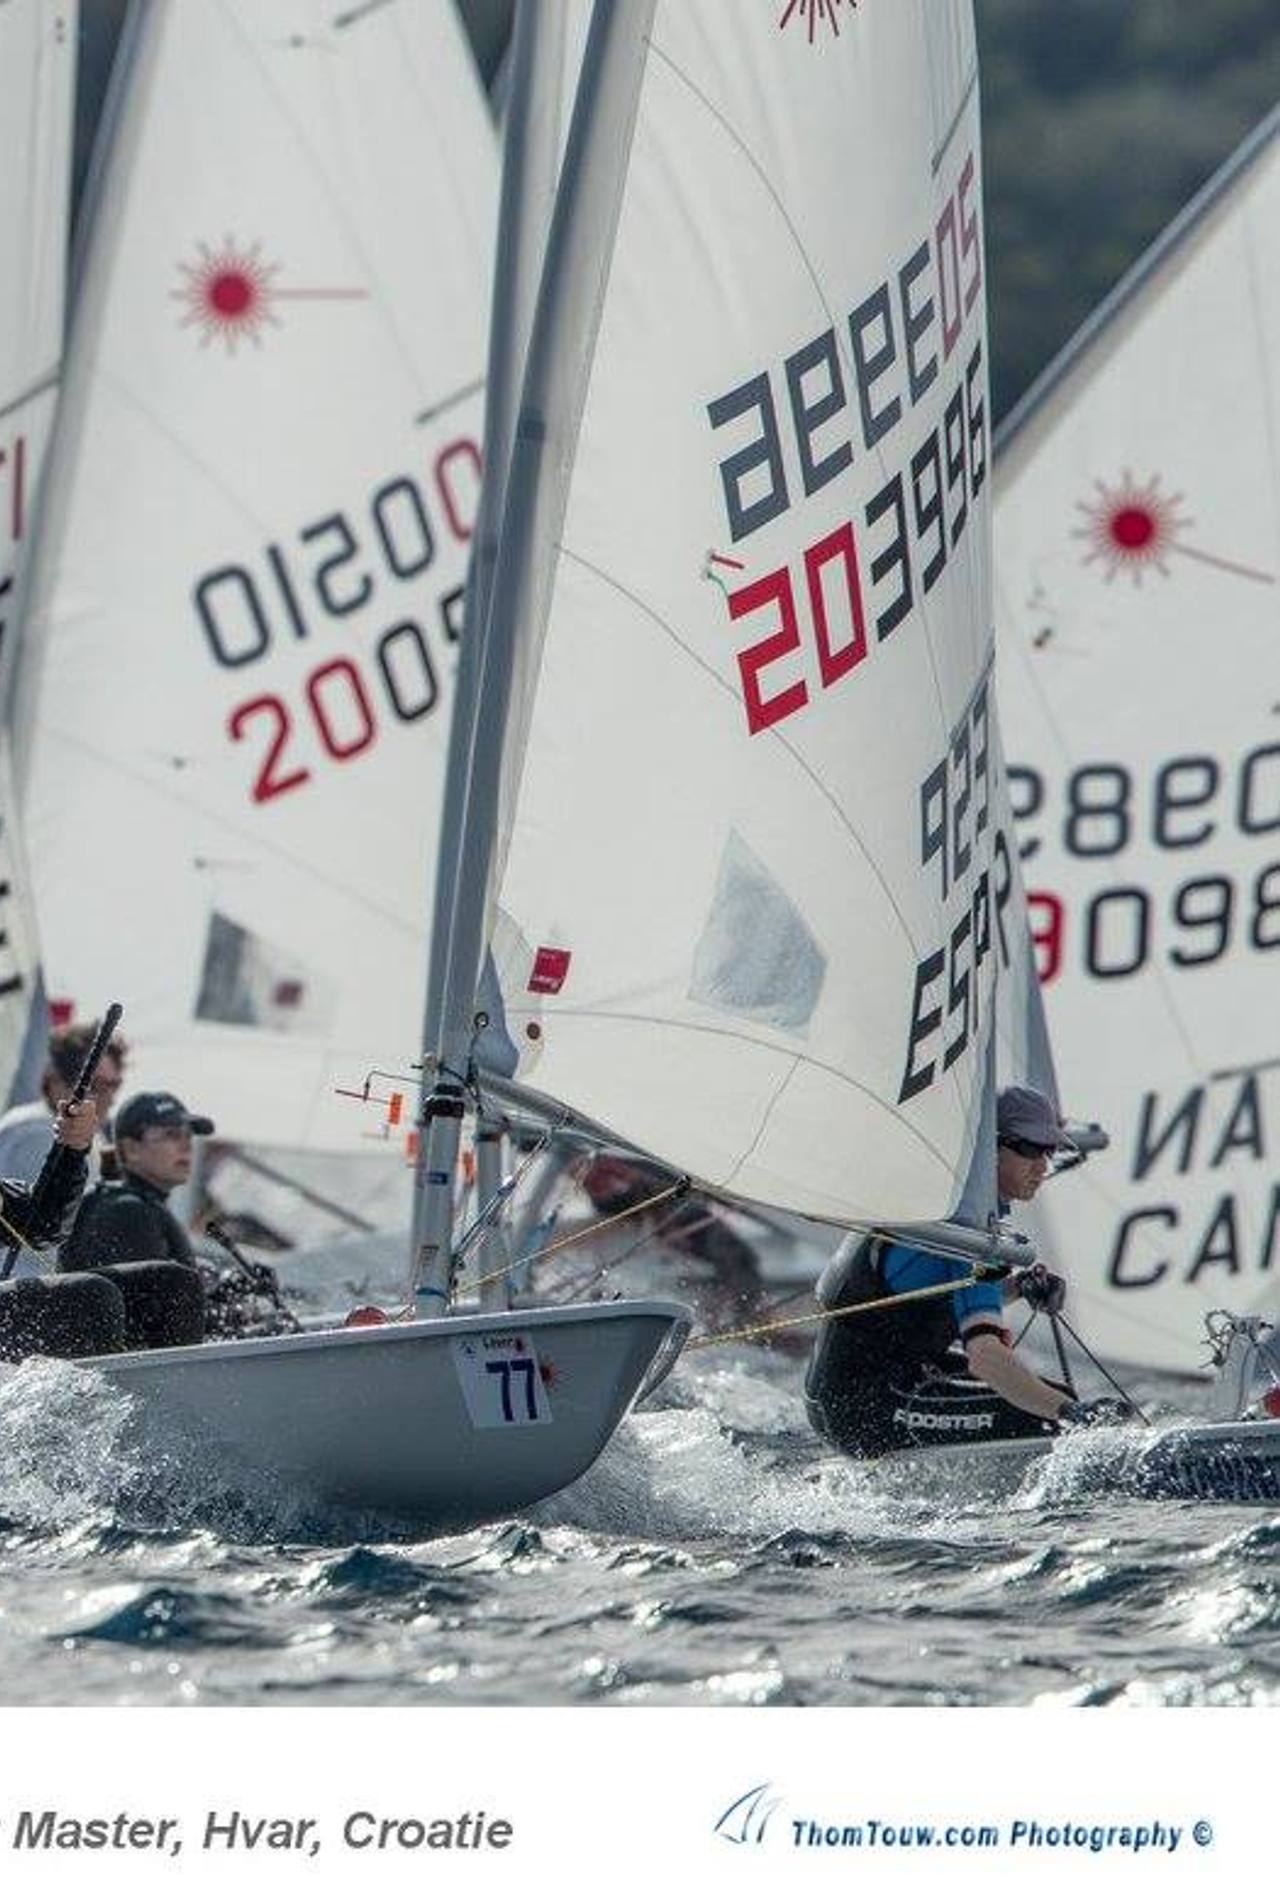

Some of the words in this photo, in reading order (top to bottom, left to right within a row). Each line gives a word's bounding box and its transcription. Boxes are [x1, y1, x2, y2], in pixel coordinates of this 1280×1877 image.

[726, 337, 987, 737] 203996
[228, 583, 468, 804] 200
[898, 870, 991, 1106] ESP
[485, 1358, 539, 1422] 77
